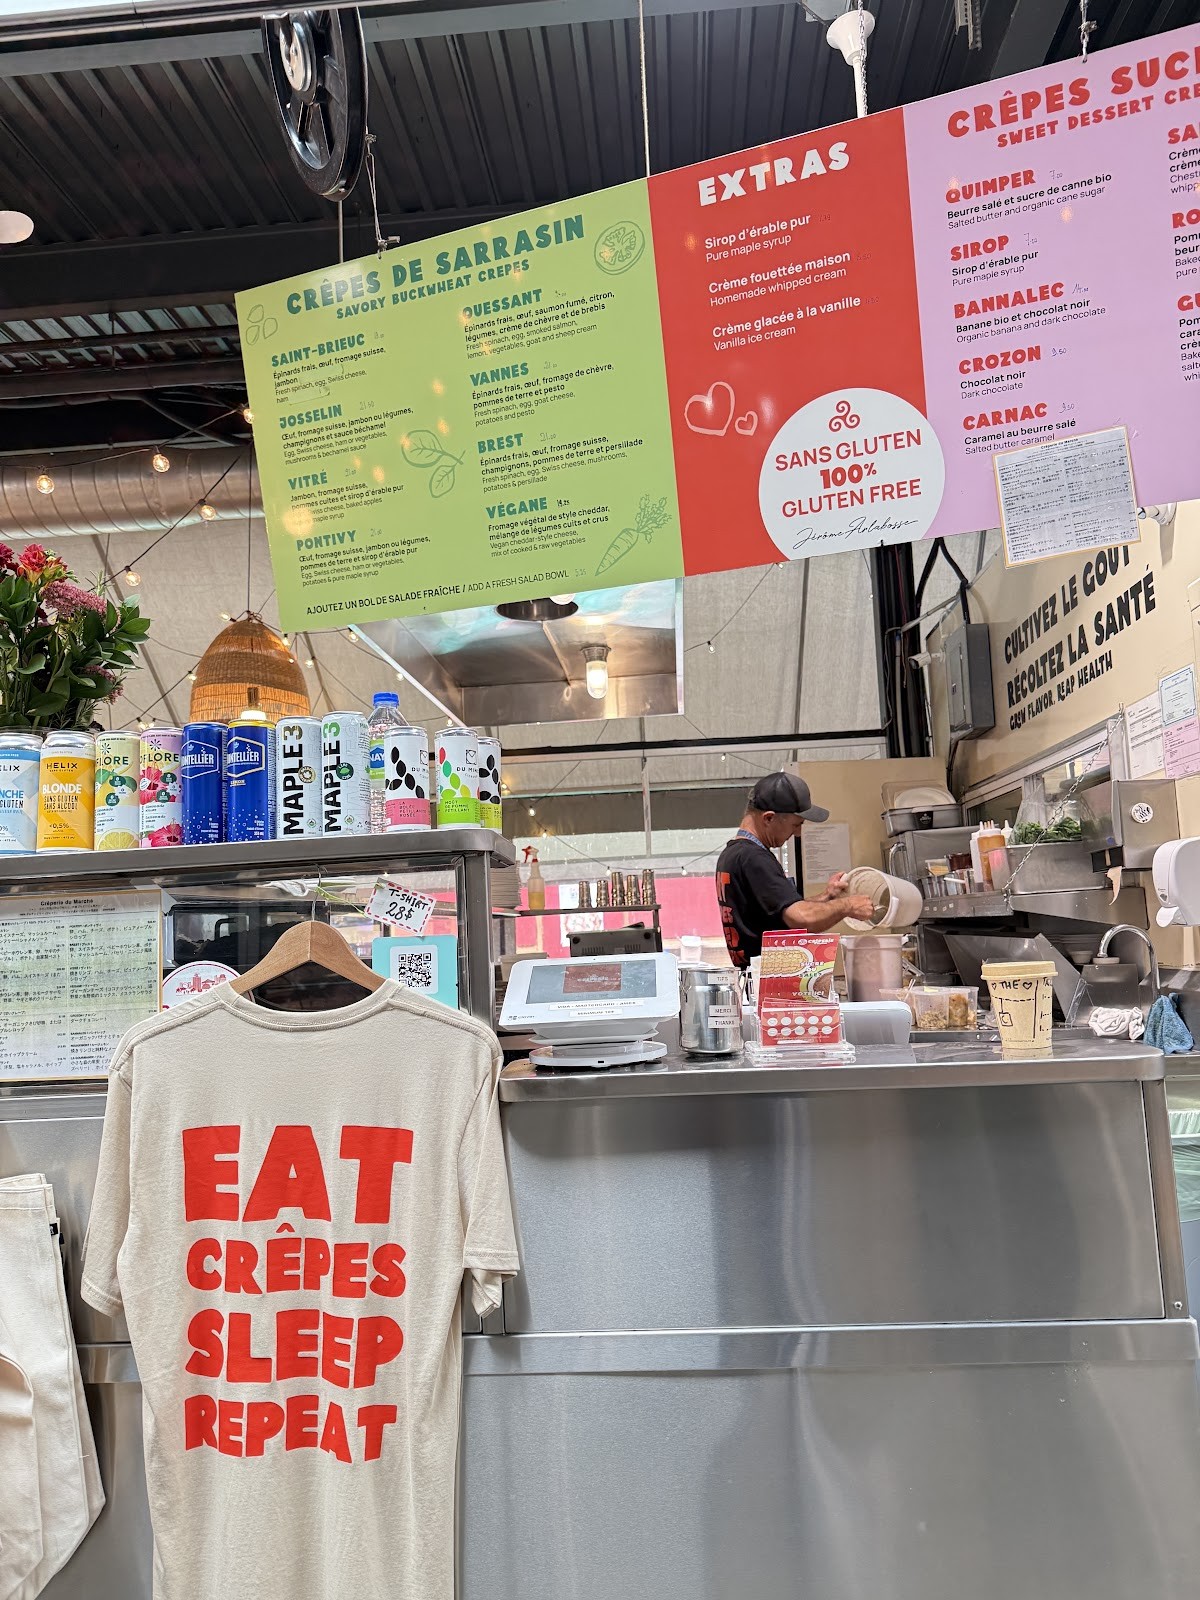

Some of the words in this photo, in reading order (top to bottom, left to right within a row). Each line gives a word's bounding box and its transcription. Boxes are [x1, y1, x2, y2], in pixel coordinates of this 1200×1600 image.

[948, 78, 1090, 138] CRÊPES
[997, 120, 1058, 148] SWEET
[1068, 95, 1154, 130] DESSERT
[698, 142, 849, 206] EXTRAS
[946, 169, 1035, 203] QUIMPER
[947, 203, 980, 219] Beurre
[981, 198, 1002, 211] salé
[1004, 197, 1015, 205] et
[1016, 190, 1045, 203] sucre
[1047, 186, 1060, 196] de
[1061, 179, 1093, 192] canne
[1095, 172, 1112, 184] bio
[949, 216, 975, 229] Salted
[976, 209, 1003, 223] butter
[1004, 206, 1021, 217] and
[1022, 198, 1055, 214] organic
[1057, 193, 1078, 205] cane
[1079, 187, 1105, 200] sugar
[705, 233, 736, 249] Sirop
[790, 214, 810, 231] pur
[706, 250, 729, 262] Pure
[731, 242, 761, 256] maple
[763, 234, 791, 249] syrup
[950, 235, 1009, 261] SIROP
[287, 271, 380, 314] CRÊPES
[392, 259, 423, 287] DE
[436, 215, 584, 275] SARRASIN
[709, 273, 748, 293] Crème
[750, 263, 803, 283] fouettée
[805, 252, 850, 271] maison
[952, 262, 978, 276] Sirop
[1022, 252, 1038, 264] pur
[952, 277, 972, 286] Pure
[973, 270, 999, 283] maple
[1000, 265, 1024, 277] syrup
[337, 297, 386, 319] SAVORY
[392, 274, 472, 306] BUCKWHEAT
[479, 259, 530, 282] CREPES
[710, 288, 766, 306] Homemade
[768, 275, 811, 293] whipped
[814, 268, 846, 282] cream
[954, 282, 1064, 319] BANNALEC
[712, 320, 752, 338] Crème
[754, 311, 794, 331] glacée
[796, 308, 804, 318] à
[806, 306, 817, 317] la
[819, 296, 860, 314] vanille
[957, 320, 992, 333] Banane
[994, 316, 1009, 326] bio
[1011, 313, 1021, 322] et
[1024, 305, 1068, 319] chocolat
[1070, 298, 1090, 308] noir
[957, 330, 989, 343] Organic
[991, 323, 1022, 336] banana
[1023, 319, 1039, 330] and
[1042, 315, 1060, 326] dark
[1062, 307, 1106, 322] chocolate
[272, 334, 365, 367] SAINT-BRIEUC
[714, 334, 745, 351] Vanilla
[748, 331, 762, 342] ice
[764, 326, 796, 340] cream
[470, 362, 529, 386] VANNES
[959, 346, 1041, 374] CROZON
[960, 373, 1004, 389] Chocolat
[1006, 371, 1026, 380] noir
[961, 390, 980, 400] Dark
[982, 382, 1023, 396] chocolate
[280, 404, 342, 429] JOSSELIN
[963, 402, 1048, 430] CARNAC
[964, 431, 1005, 445] Caramel
[1007, 429, 1018, 437] au
[1021, 422, 1053, 435] beurre
[1055, 418, 1076, 430] salé
[478, 433, 523, 453] BREST
[775, 446, 831, 471] SANS
[836, 429, 921, 460] GLUTEN
[966, 444, 992, 455] Salted
[993, 439, 1019, 449] butter
[1021, 434, 1055, 446] caramel
[288, 469, 327, 490] VITRÉ
[820, 463, 877, 489] 100%
[486, 497, 547, 518] VÉGANE
[782, 489, 864, 517] GLUTEN
[870, 479, 921, 503] FREE
[488, 520, 518, 531] Fromage
[520, 515, 547, 527] végétal
[558, 510, 576, 520] style
[489, 528, 519, 540] mélange
[531, 523, 561, 534] légumes
[562, 520, 581, 529] cuits
[296, 530, 356, 551] PONTIVY
[307, 603, 344, 615] AJOUTEZ
[346, 600, 357, 609] UN
[359, 598, 376, 608] BOL
[376, 595, 387, 605] DE
[389, 591, 422, 604] SALADE
[423, 585, 461, 599] FRAÎCHE
[468, 581, 484, 592] ADD
[485, 582, 491, 590] A
[492, 577, 517, 589] FRESH
[518, 572, 544, 585] SALAD
[546, 570, 569, 580] BOWL
[1005, 593, 1057, 664] CULTIVEZ
[1062, 575, 1078, 616] LE
[1007, 641, 1064, 708] RÉCOLTEZ
[1068, 624, 1089, 666] LA
[1094, 564, 1155, 646] SANTÉ
[1077, 650, 1112, 688] HEALTH
[283, 725, 303, 740] 3
[323, 722, 340, 738] 3
[42, 784, 82, 794] BLONDE
[283, 744, 303, 834] MAPLE
[324, 741, 341, 832] MAPLE
[386, 902, 414, 920] 28$
[389, 889, 428, 910] T-SHIRT
[182, 1125, 413, 1223] EAT
[187, 1222, 406, 1298] CRÊPES
[186, 1309, 403, 1388] SLEEP
[185, 1395, 397, 1463] REPEAT
